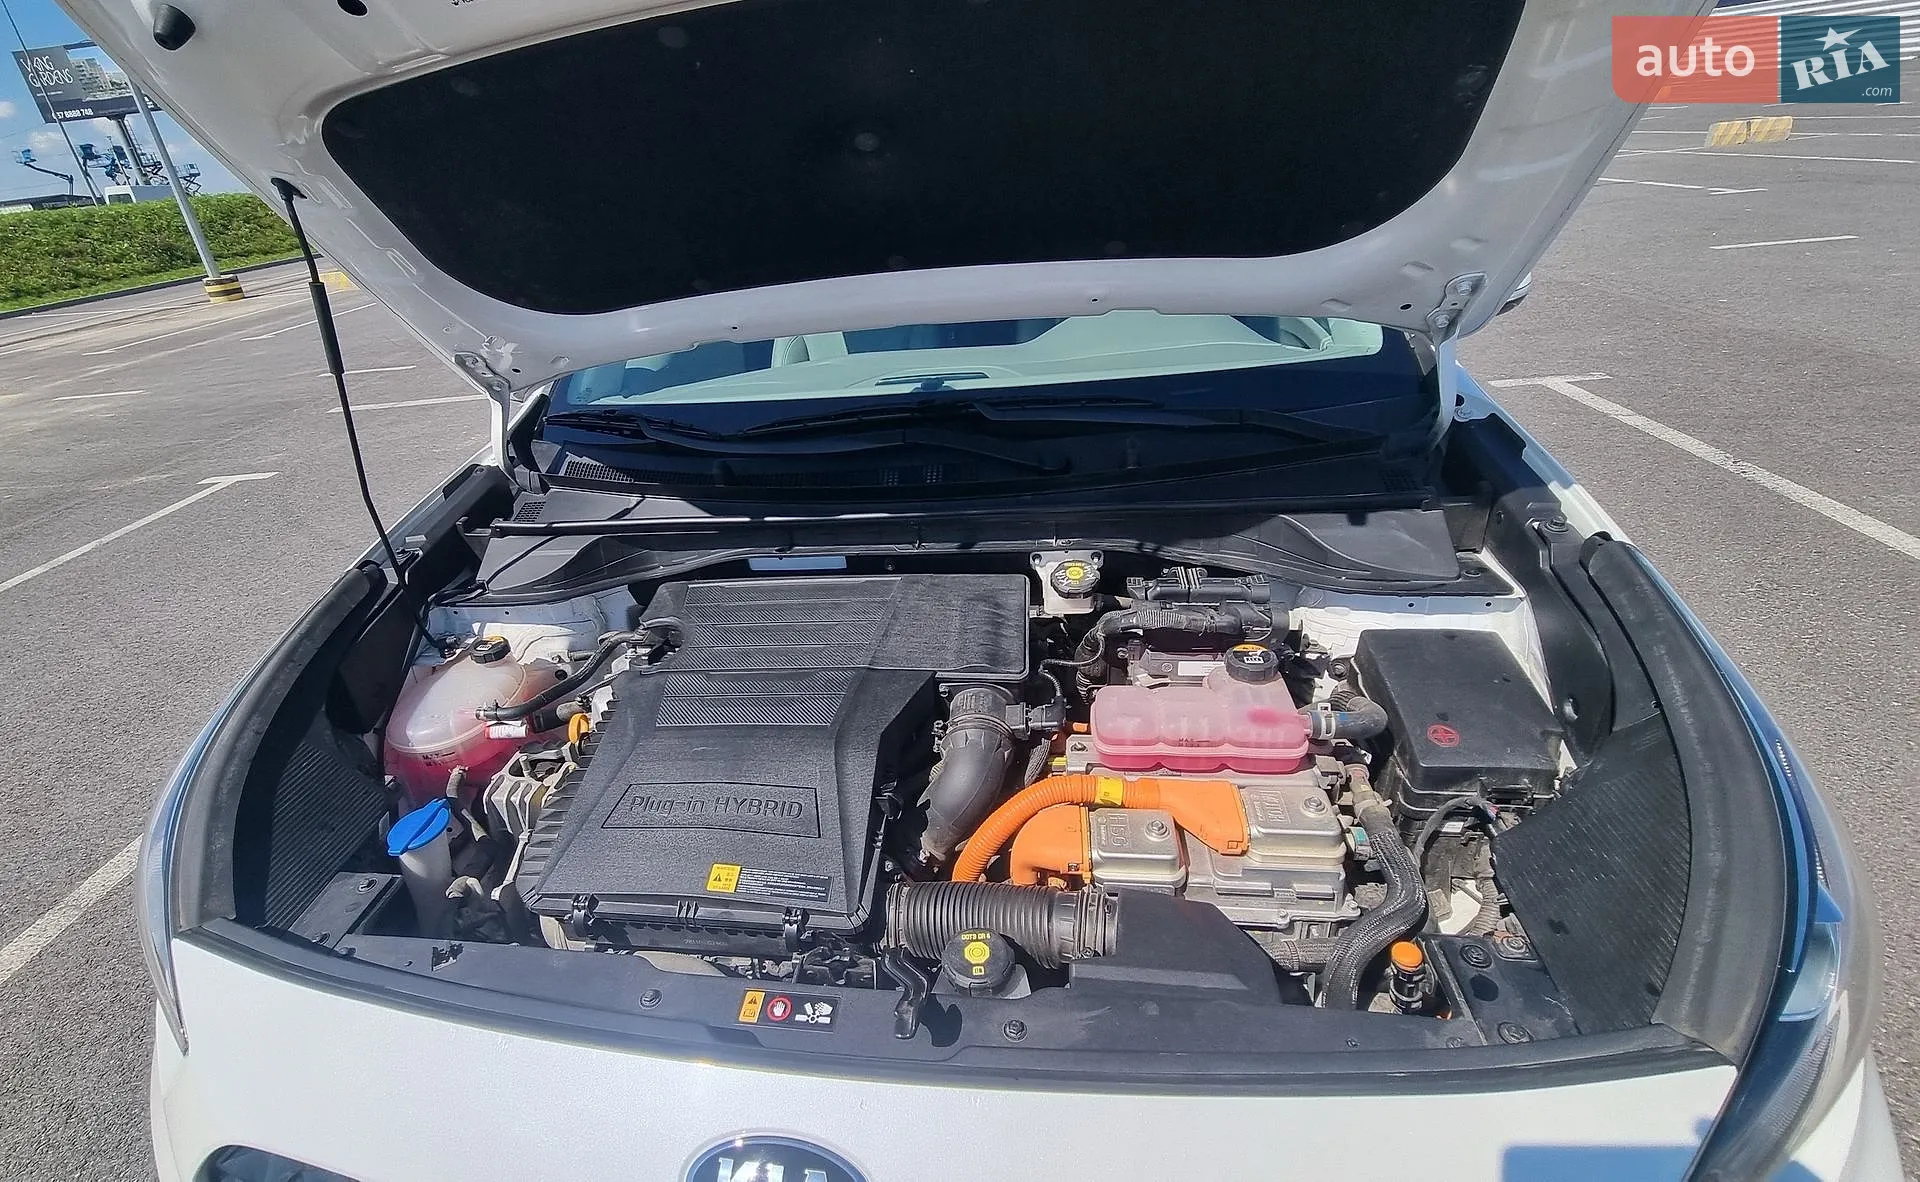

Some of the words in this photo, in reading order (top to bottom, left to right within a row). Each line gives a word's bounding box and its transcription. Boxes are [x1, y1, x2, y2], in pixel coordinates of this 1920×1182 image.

[20, 55, 54, 72] VKING
[28, 68, 73, 87] GRDENS
[630, 795, 705, 816] Plug-in
[714, 797, 804, 819] HYBRID
